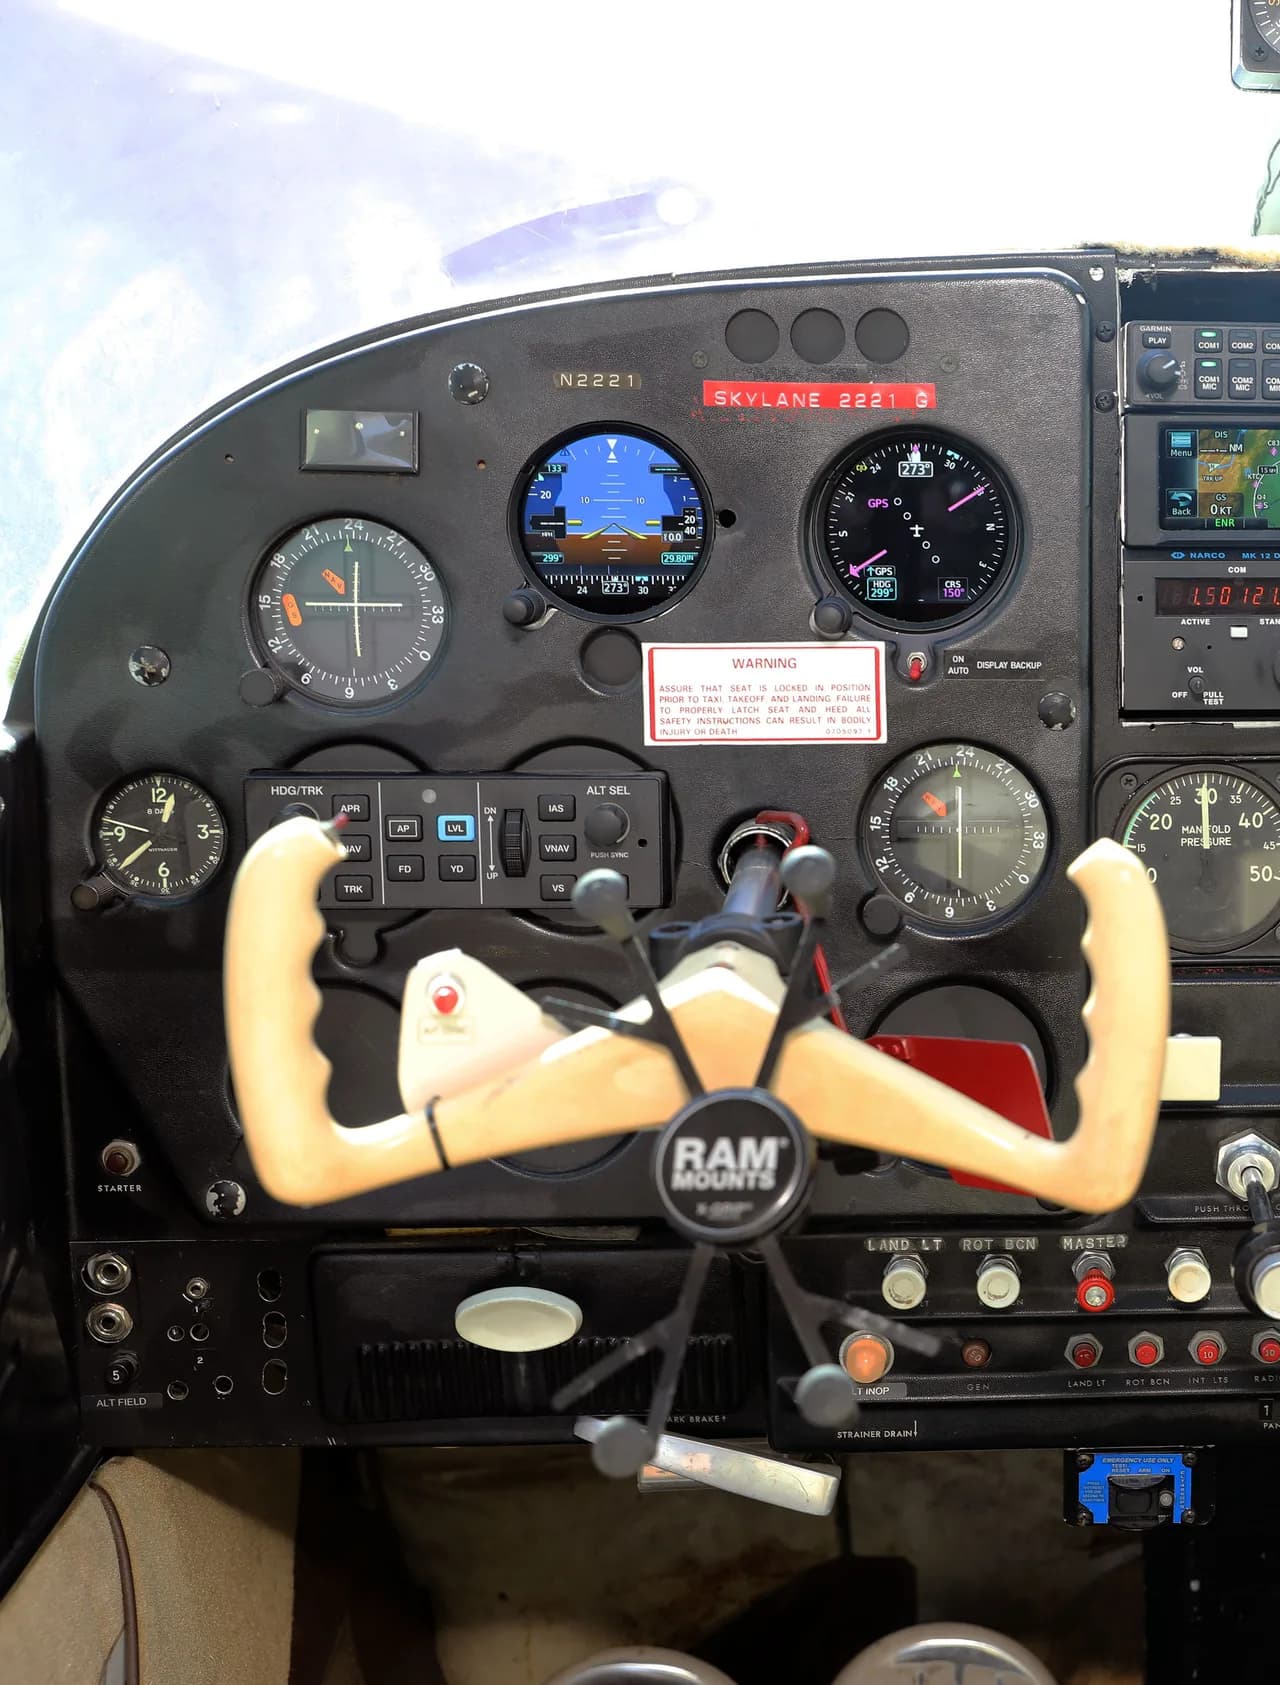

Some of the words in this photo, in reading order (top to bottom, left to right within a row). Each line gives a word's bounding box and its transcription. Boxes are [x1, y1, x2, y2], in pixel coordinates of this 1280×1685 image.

[1148, 337, 1167, 345] PLAY
[560, 374, 635, 387] N2221
[714, 391, 820, 406] SKYLANE
[840, 393, 896, 408] 2221
[915, 393, 929, 408] G
[868, 499, 889, 508] GPS
[1172, 508, 1191, 516] Back
[1215, 519, 1235, 527] ENR
[577, 586, 588, 594] 24
[638, 586, 648, 594] 30
[732, 658, 797, 669] WARNING
[977, 661, 1008, 669] DISPLAY
[1010, 661, 1042, 669] BACKUP
[948, 667, 969, 675] AUTO
[659, 685, 693, 693] ASSURE
[774, 684, 808, 692] LOCKED
[815, 684, 824, 692] IN
[680, 706, 723, 714] PROPERLY
[732, 706, 759, 714] LATCH
[856, 705, 871, 713] ALL
[696, 717, 761, 725] INSTRUCTIONS
[827, 716, 836, 724] IN
[841, 716, 871, 724] BODILY
[271, 786, 323, 796] HDG/TRK
[587, 786, 605, 795] ALT
[608, 786, 630, 795] SEL
[341, 804, 360, 813] APR
[548, 804, 564, 813] IAS
[1151, 815, 1172, 830] 20
[1239, 813, 1263, 829] 40
[397, 824, 410, 833] AP
[447, 824, 464, 833] LVL
[544, 844, 570, 853] VNAV
[399, 864, 411, 873] FD
[450, 864, 463, 873] YD
[1250, 866, 1273, 882] 50
[343, 884, 363, 894] TRK
[552, 884, 564, 893] VS
[672, 1170, 776, 1191] MOUNTS
[867, 1239, 909, 1251] LAND
[921, 1239, 943, 1251] LT
[963, 1239, 993, 1250] ROT
[1006, 1238, 1036, 1250] BCN
[1063, 1236, 1126, 1250] MASTER
[866, 1387, 890, 1395] INOP
[96, 1398, 116, 1407] ALT
[118, 1397, 146, 1406] FIELD
